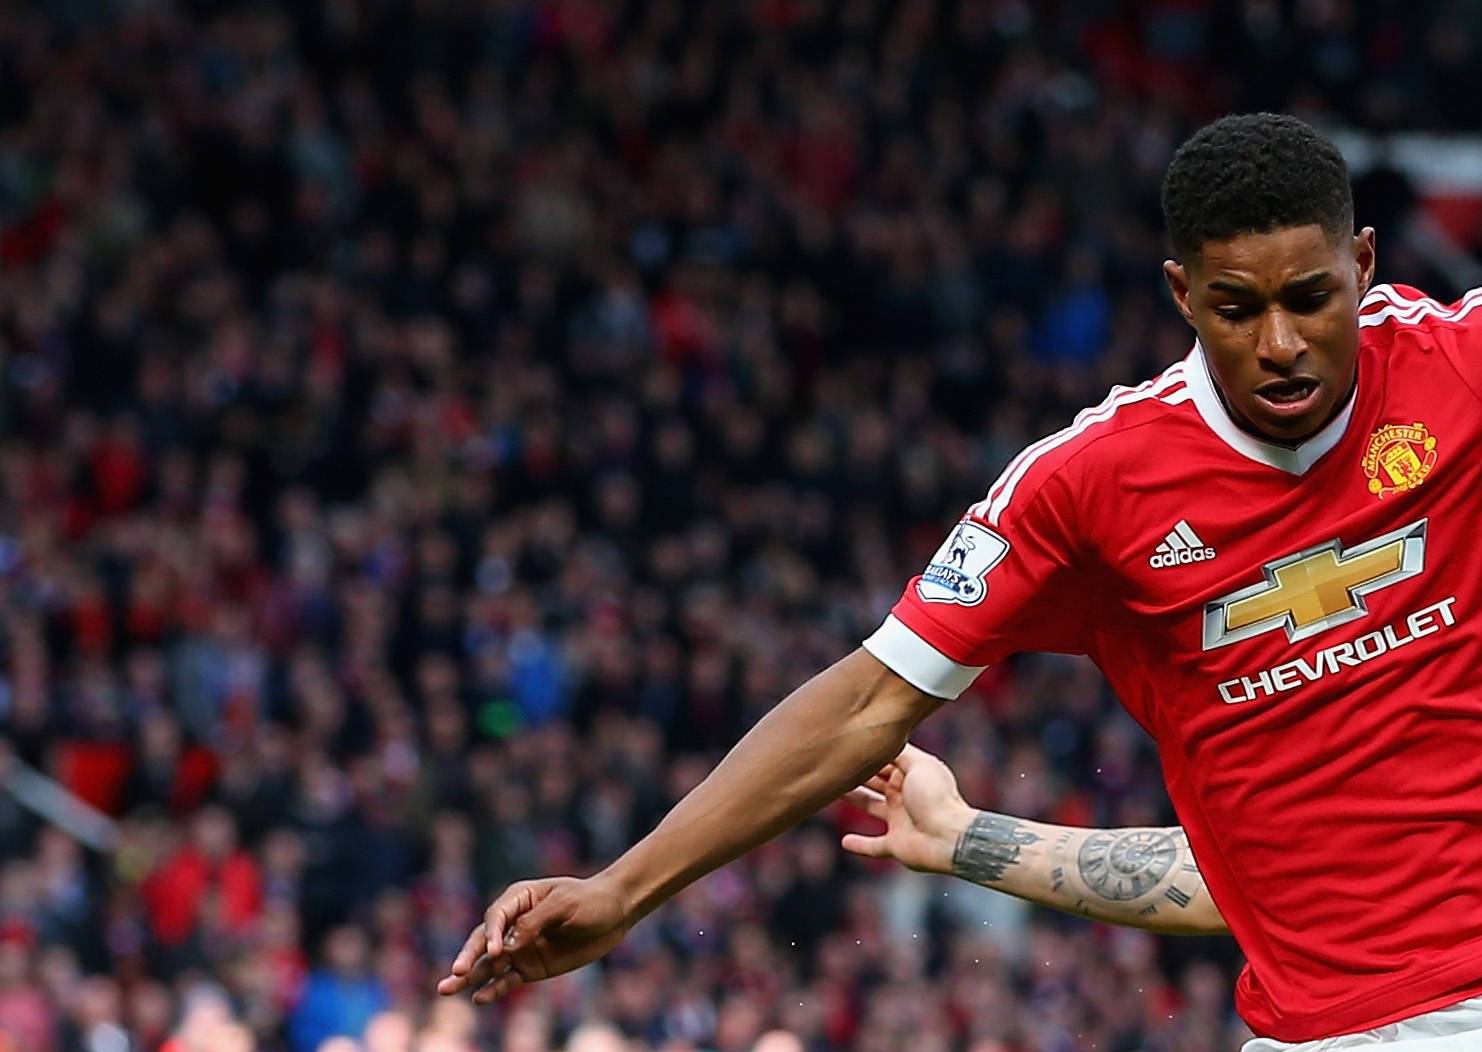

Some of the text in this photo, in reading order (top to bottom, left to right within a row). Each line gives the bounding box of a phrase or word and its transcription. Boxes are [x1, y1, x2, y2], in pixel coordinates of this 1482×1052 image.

[1367, 429, 1423, 471] MANCHESTER
[1149, 545, 1216, 569] adidas
[1217, 596, 1457, 704] CHEVROLET
